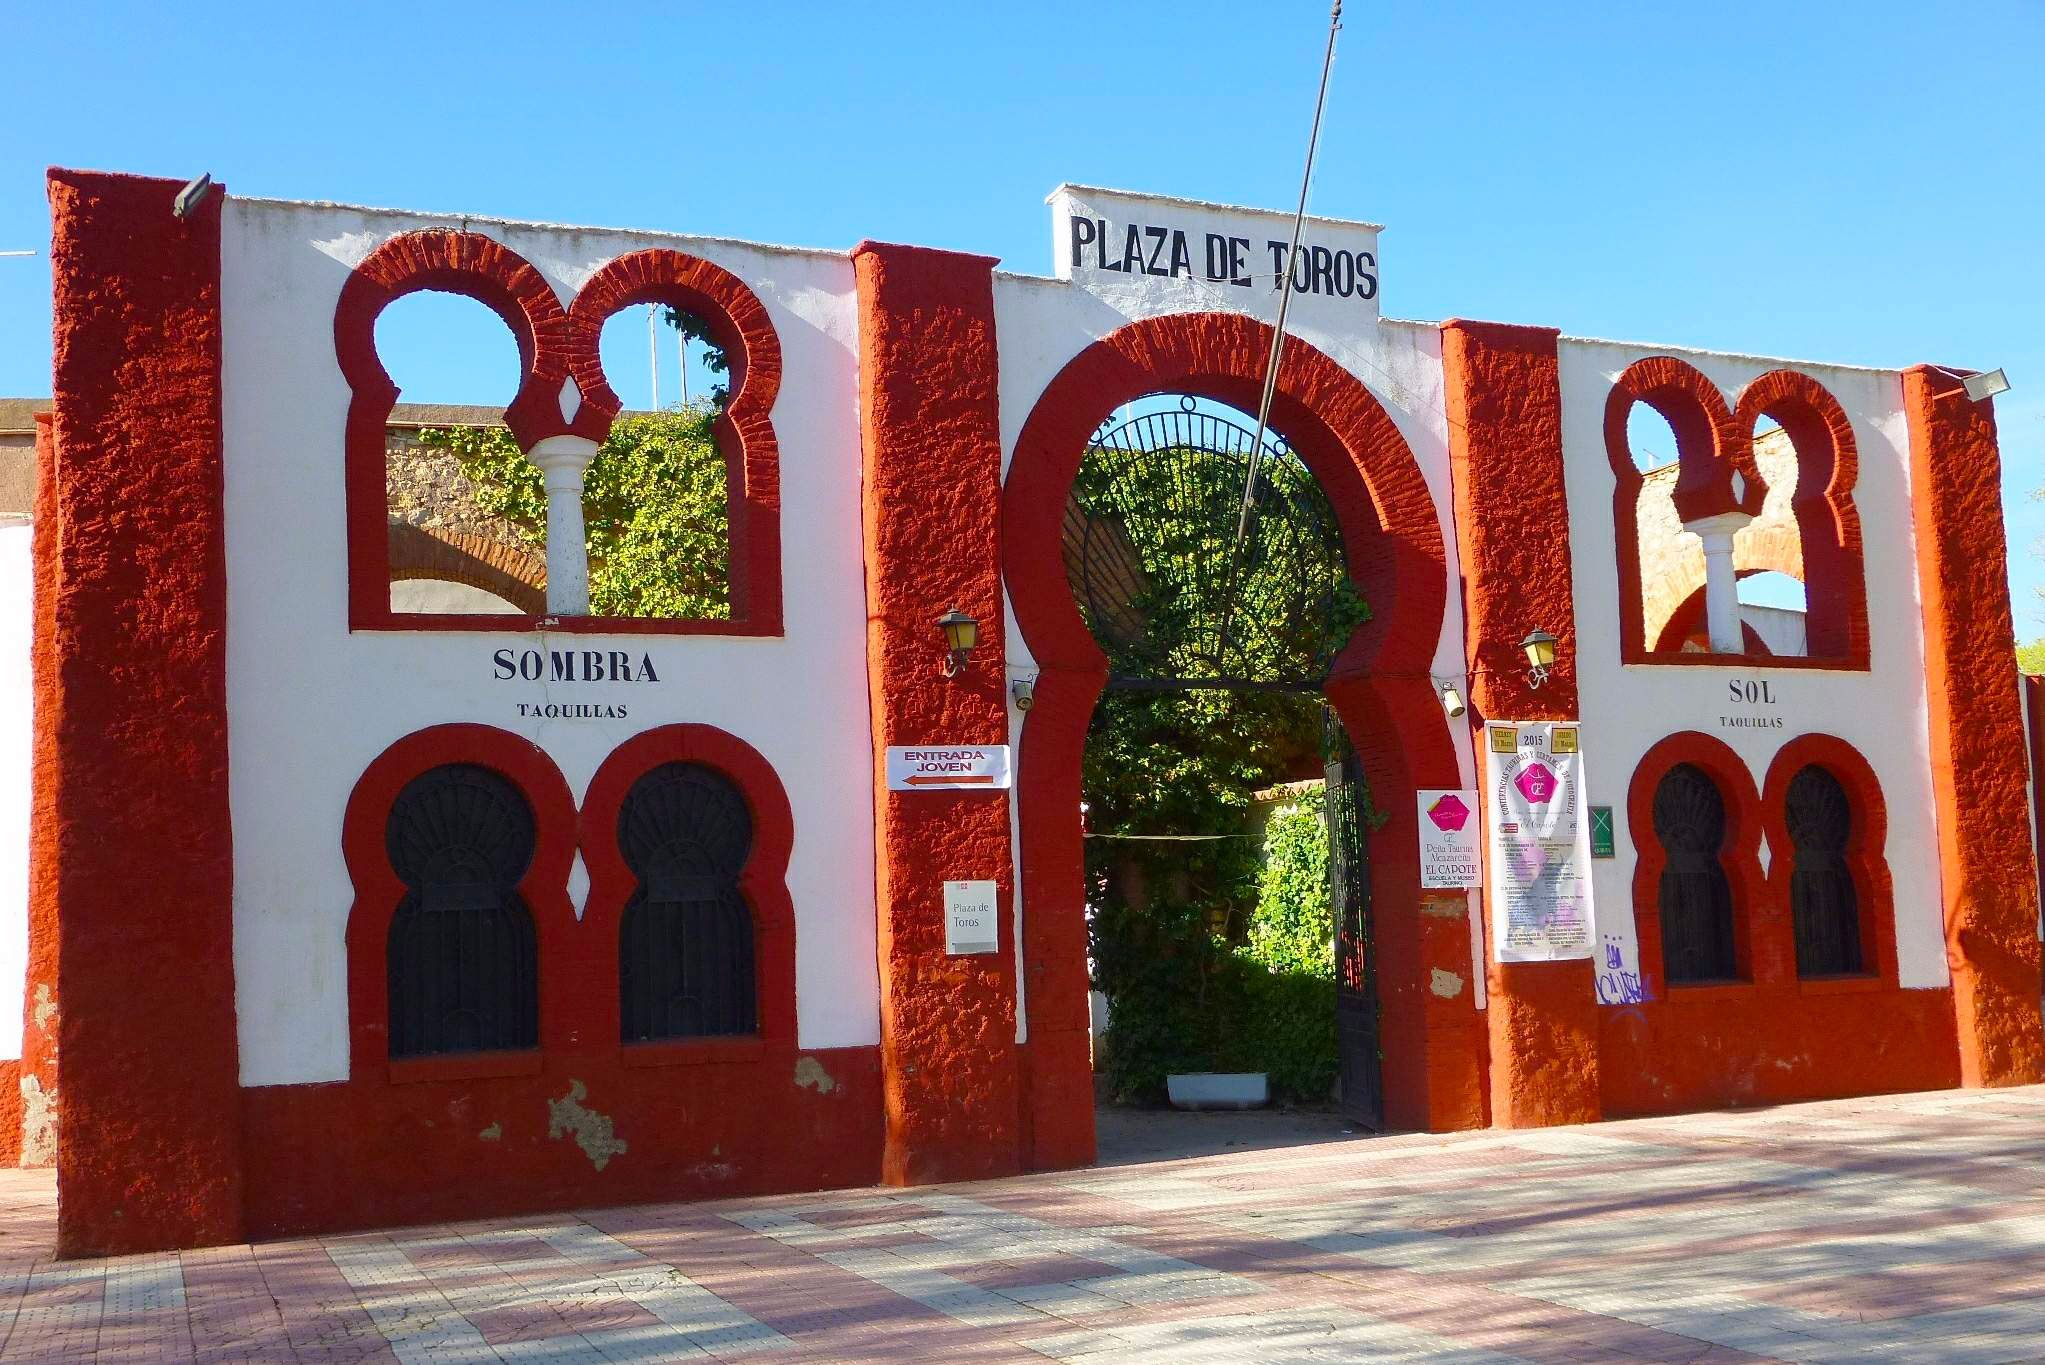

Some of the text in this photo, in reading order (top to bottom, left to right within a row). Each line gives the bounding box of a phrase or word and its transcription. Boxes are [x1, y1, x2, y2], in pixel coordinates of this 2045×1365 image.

[1071, 215, 1377, 299] PLAZA DE TOROS
[493, 649, 660, 682] SOMBRA
[1729, 679, 1776, 703] SOL
[517, 703, 627, 718] TAQUILLAS
[1719, 716, 1783, 728] TAQUILLAS
[1524, 735, 1543, 745] 2015
[904, 751, 985, 760] ENTRADA
[917, 762, 971, 772] JOVEN
[1425, 864, 1477, 874] EL CAPOTE
[954, 903, 989, 912] Plaza de
[953, 916, 979, 927] Toros
